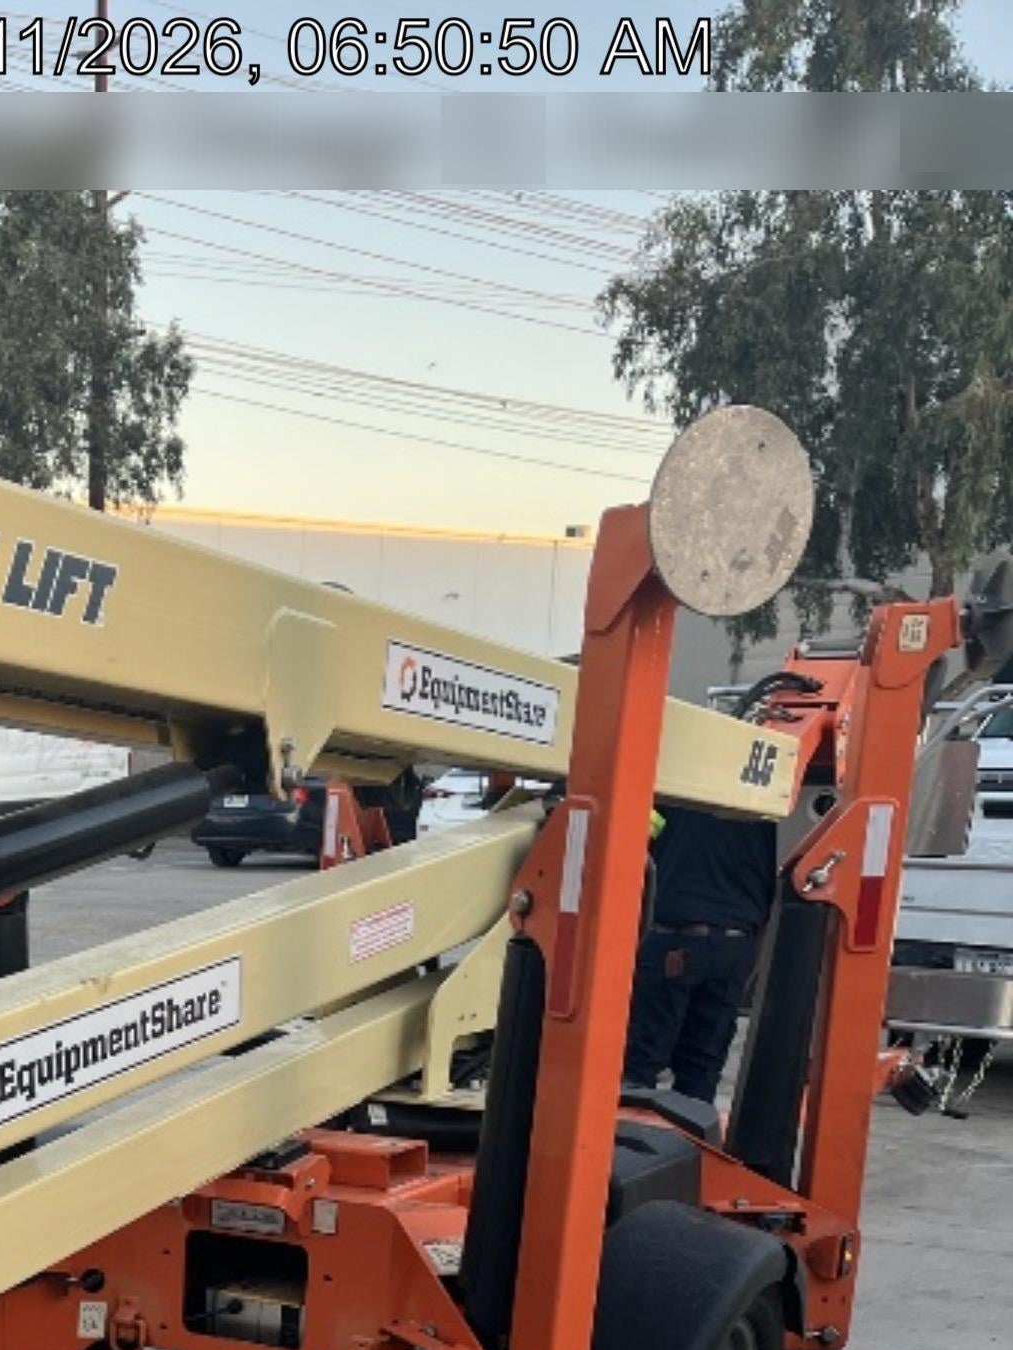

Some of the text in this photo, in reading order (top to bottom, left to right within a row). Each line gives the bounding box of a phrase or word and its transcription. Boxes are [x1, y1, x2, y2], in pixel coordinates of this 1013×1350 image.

[1, 540, 118, 625] LIFT
[419, 665, 546, 727] EquipmentShare
[740, 740, 778, 786] JLG
